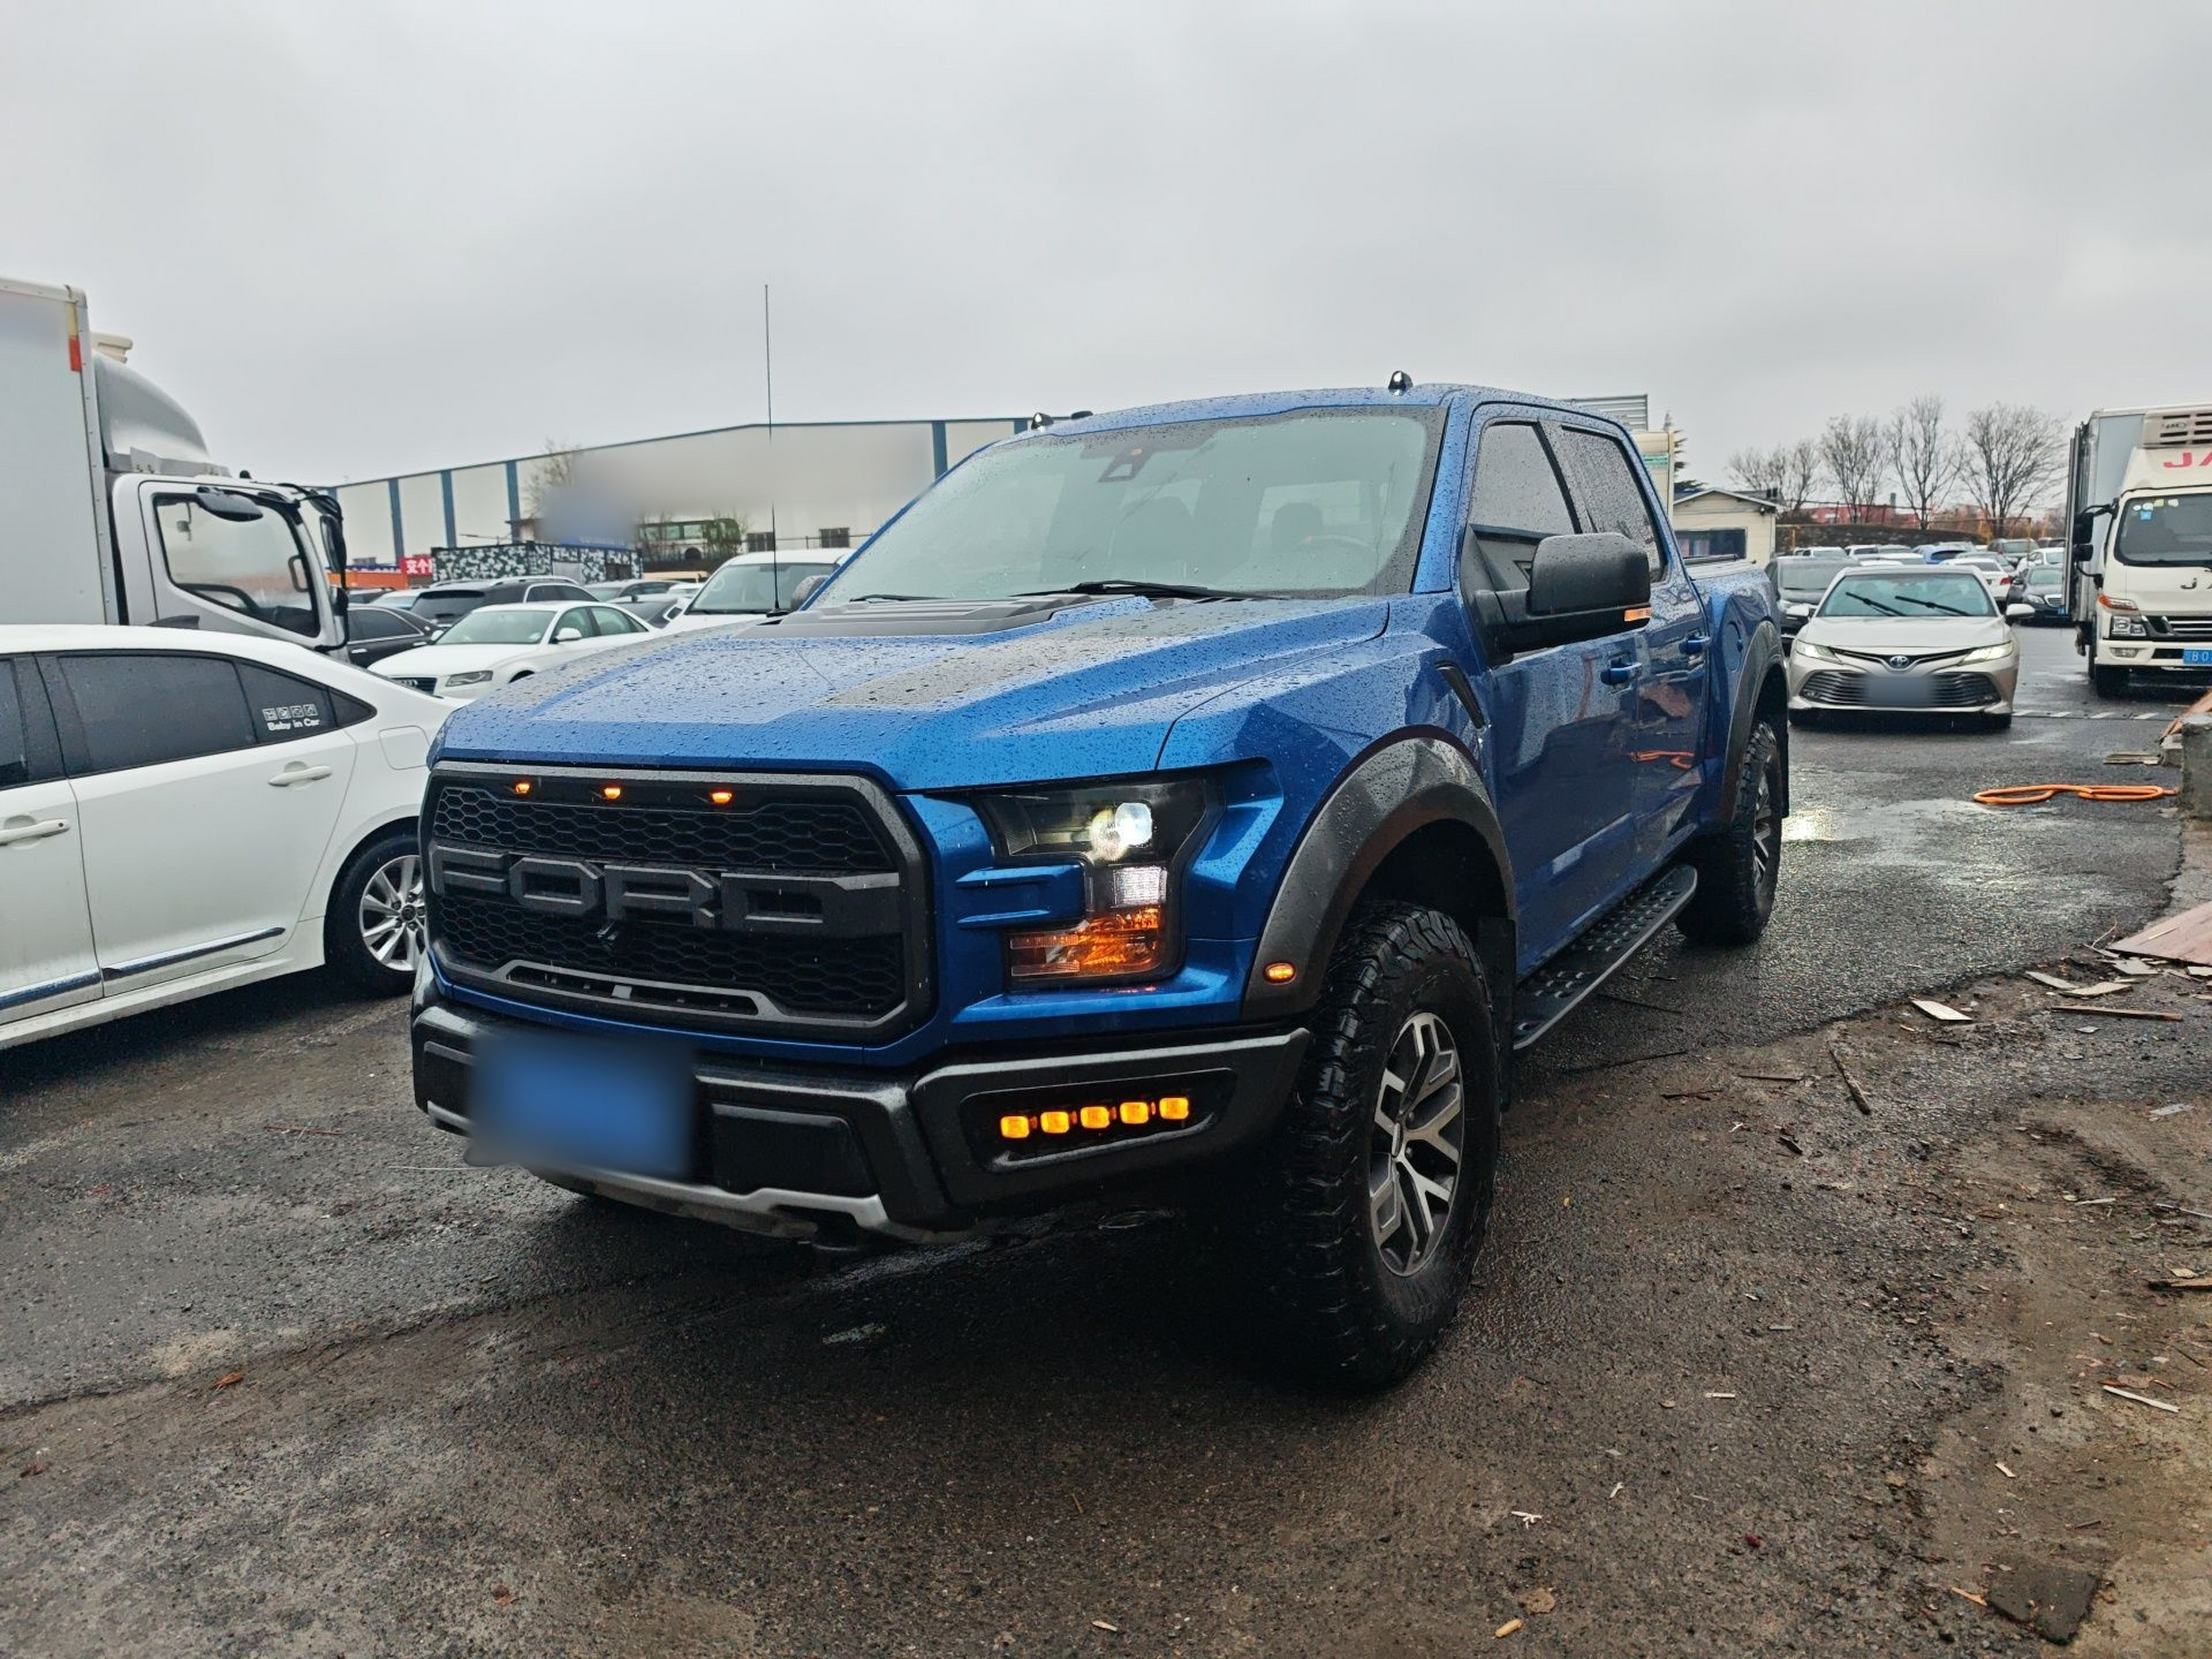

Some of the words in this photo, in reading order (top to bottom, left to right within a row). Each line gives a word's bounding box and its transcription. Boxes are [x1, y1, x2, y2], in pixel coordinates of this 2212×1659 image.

[267, 720, 291, 731] Baby
[293, 719, 302, 728] in
[304, 718, 320, 726] Car
[429, 844, 845, 935] FORD
